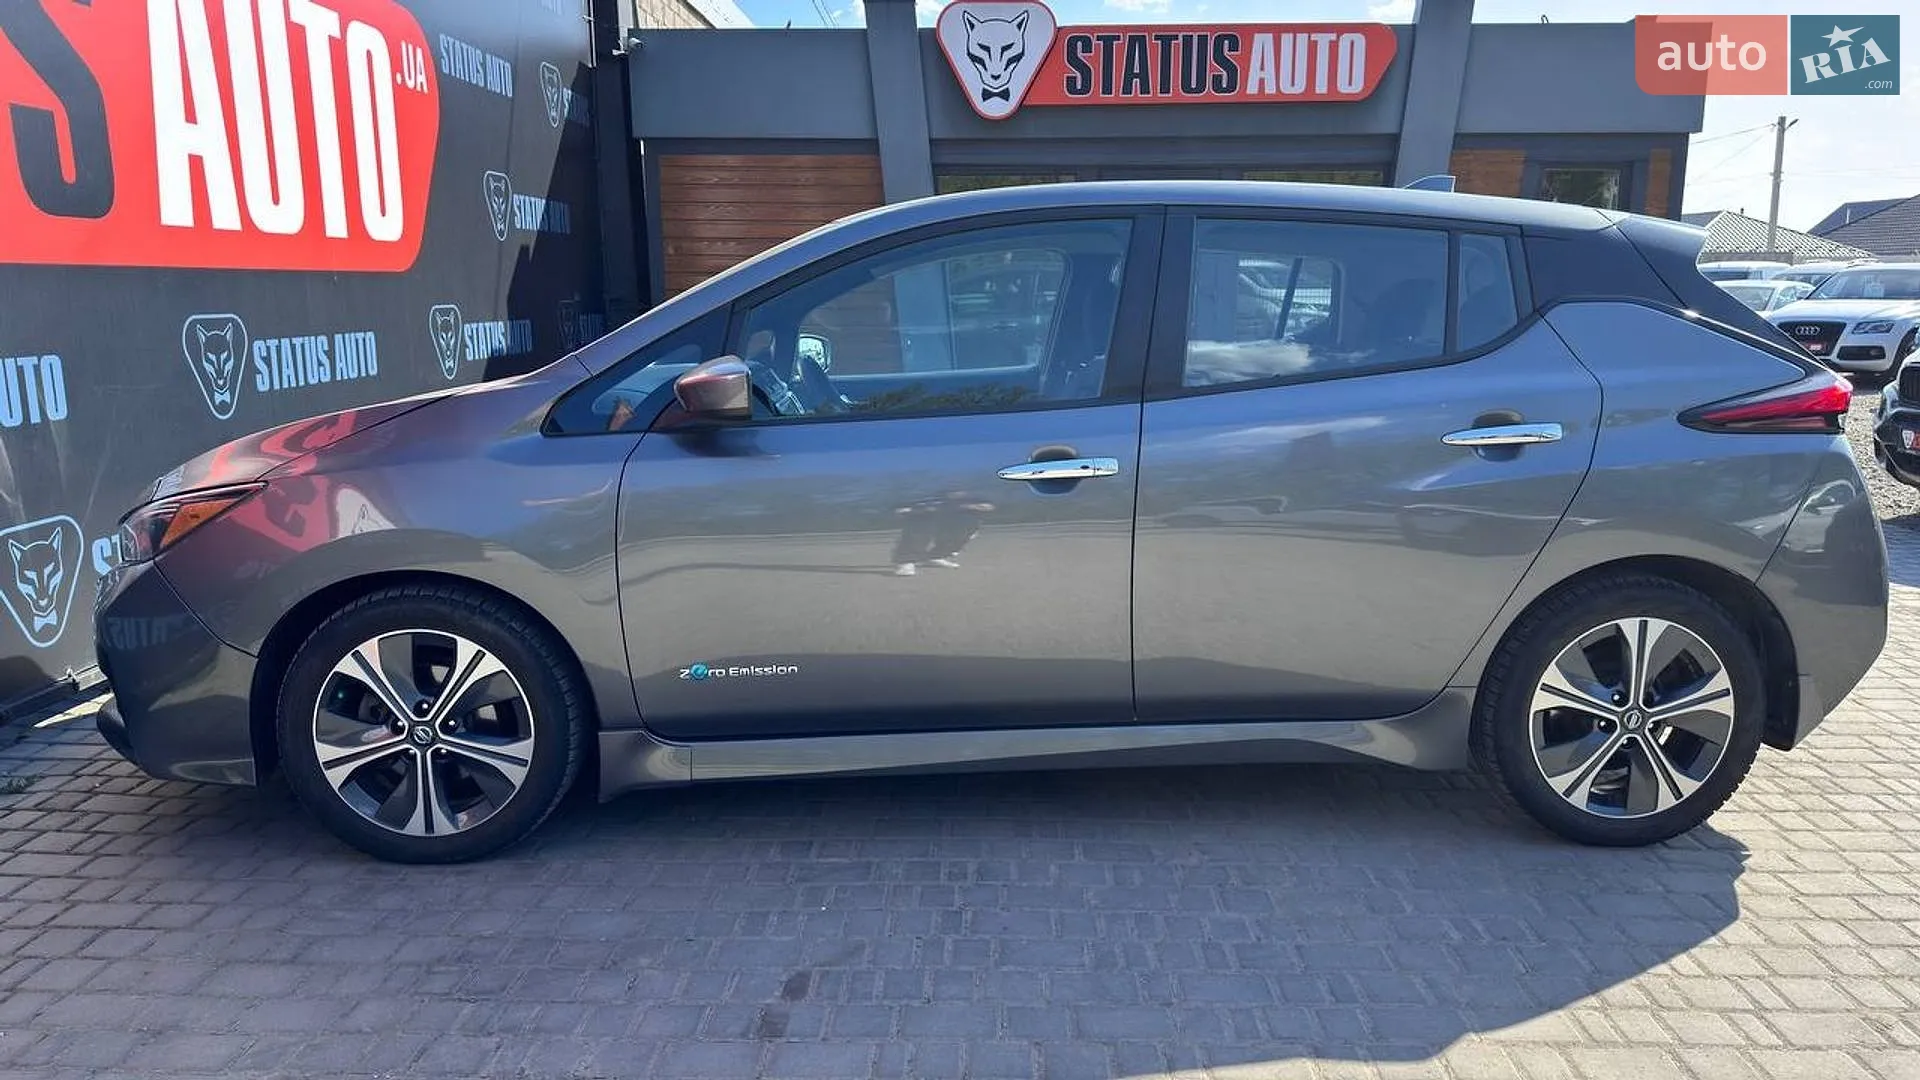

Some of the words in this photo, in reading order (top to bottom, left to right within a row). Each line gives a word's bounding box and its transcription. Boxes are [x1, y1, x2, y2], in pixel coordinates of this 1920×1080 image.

[439, 33, 484, 87] STATUS
[485, 53, 513, 98] AUTO
[1063, 32, 1240, 97] STATUS
[1246, 33, 1366, 94] AUTO
[146, 0, 403, 242] AUTO
[513, 193, 549, 232] STATUS
[252, 335, 331, 392] STATUS
[333, 331, 378, 381] AUTO
[464, 320, 507, 361] STATUS
[729, 664, 798, 678] Emission
